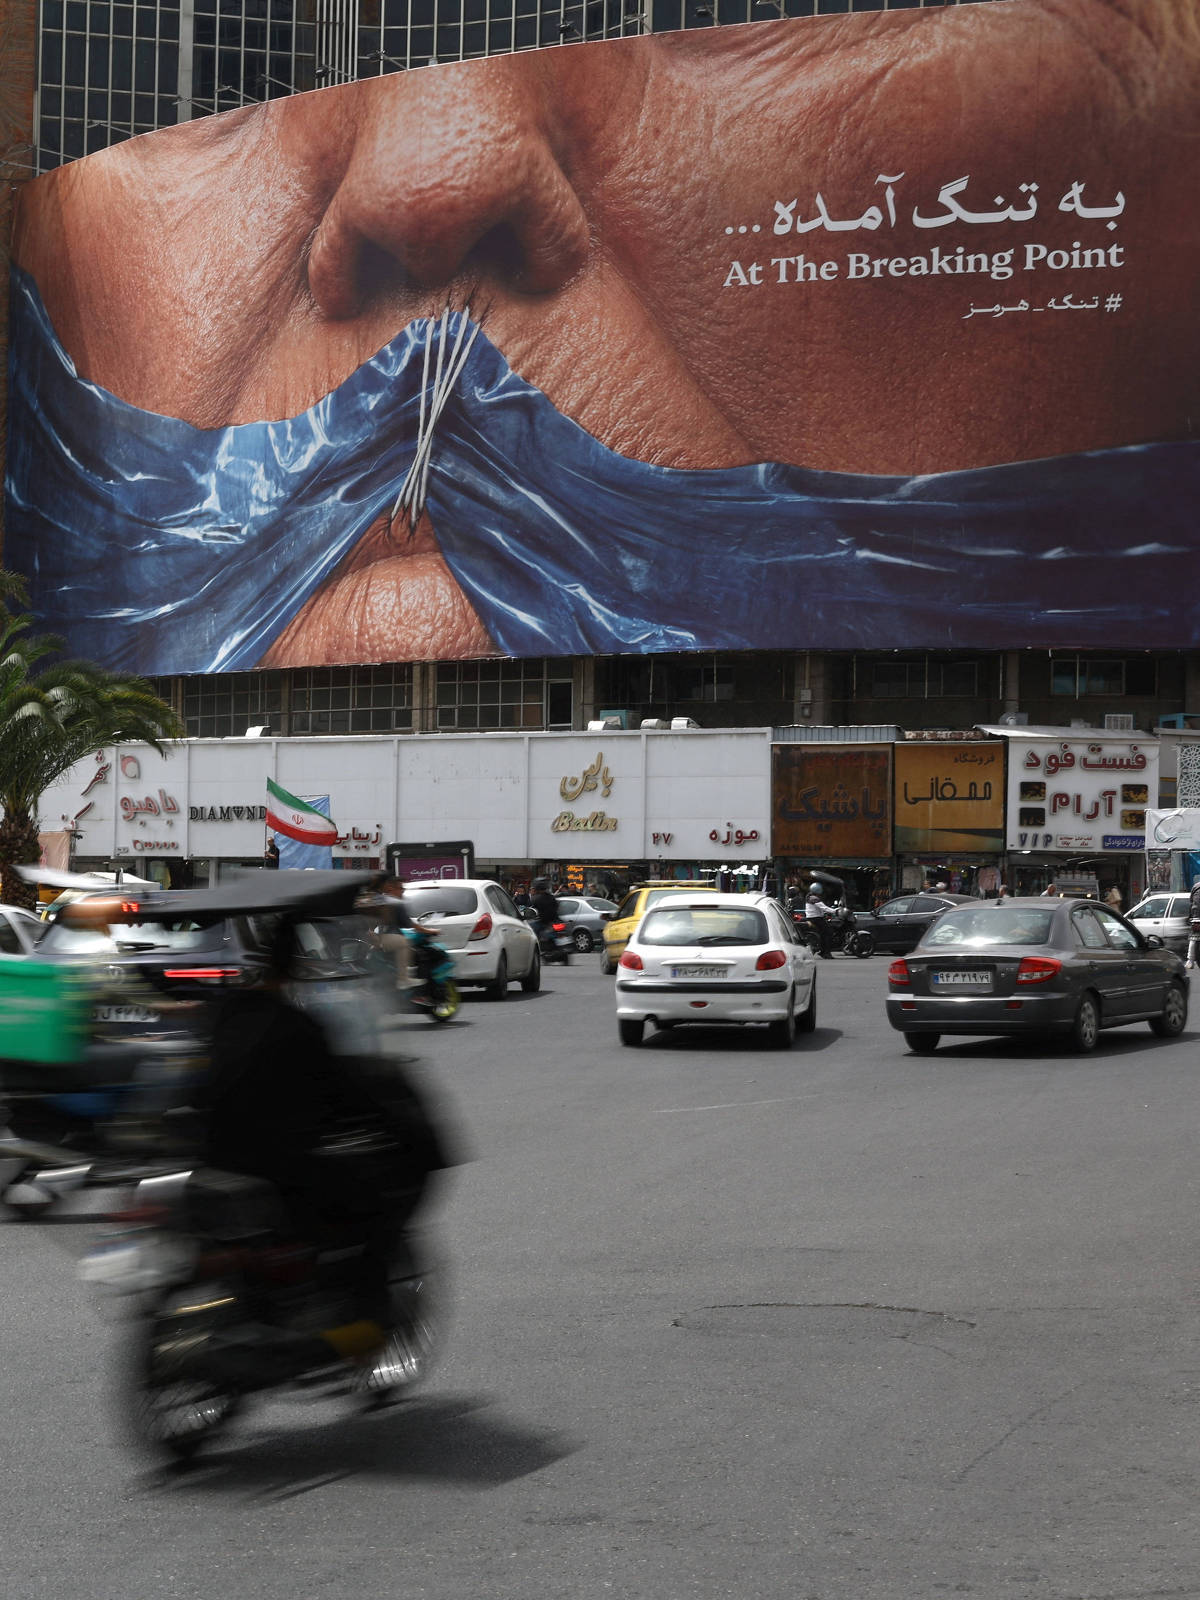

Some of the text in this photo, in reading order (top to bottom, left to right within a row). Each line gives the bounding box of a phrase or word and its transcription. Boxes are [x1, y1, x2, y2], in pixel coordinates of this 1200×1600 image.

[773, 172, 906, 236] آمده
[912, 175, 1039, 229] تنگ
[1057, 180, 1126, 231] به
[723, 241, 1125, 287] At The Breaking Point
[559, 751, 614, 801] بالین
[1025, 743, 1148, 775] فست فود
[1052, 790, 1117, 820] آرام
[708, 821, 760, 846] موزه
[1018, 832, 1053, 848] VIP
